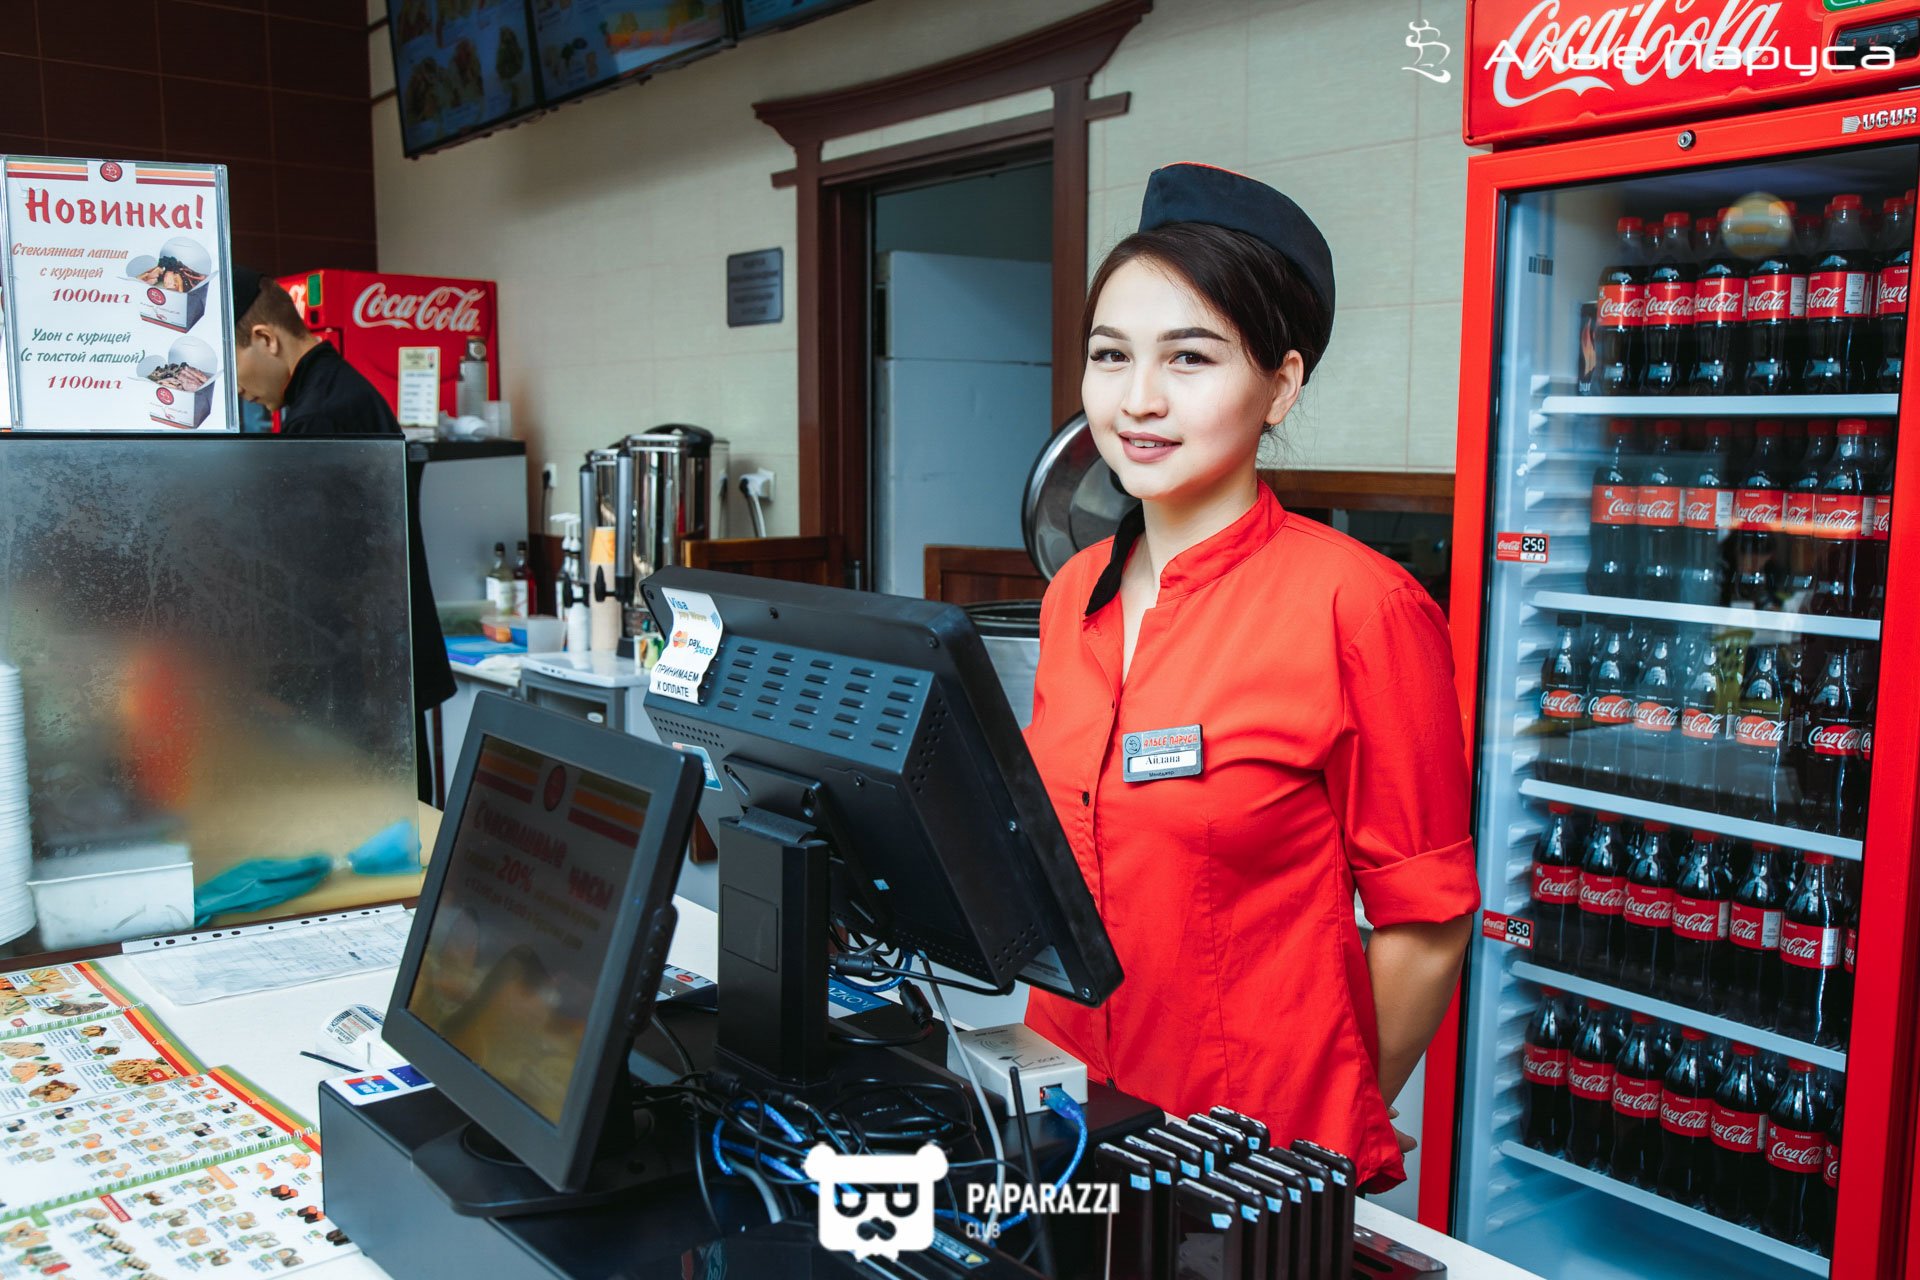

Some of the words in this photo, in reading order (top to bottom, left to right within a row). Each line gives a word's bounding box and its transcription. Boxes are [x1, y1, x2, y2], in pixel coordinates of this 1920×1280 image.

[1493, 0, 1782, 107] Coca-Cola
[1862, 106, 1918, 131] UGUR
[25, 187, 204, 230] Новинка!
[12, 242, 84, 259] Стеклянная
[87, 248, 129, 260] лапша
[39, 267, 48, 277] с
[50, 267, 104, 279] курицей
[352, 282, 486, 333] Coca-Cola
[31, 328, 62, 342] Удон
[65, 332, 74, 342] с
[77, 331, 131, 344] курицей
[20, 348, 32, 362] (с
[36, 351, 86, 363] толстой
[89, 350, 146, 364] лапшой)
[1523, 537, 1545, 551] 250
[668, 596, 689, 611] Visa
[688, 638, 700, 650] pay
[695, 645, 714, 657] pass
[655, 663, 699, 683] ПРИНИМАЕМ
[663, 682, 689, 698] ОПЛАТЕ
[1146, 755, 1180, 766] Айдана
[496, 854, 536, 894] 20%
[1508, 920, 1530, 937] 250
